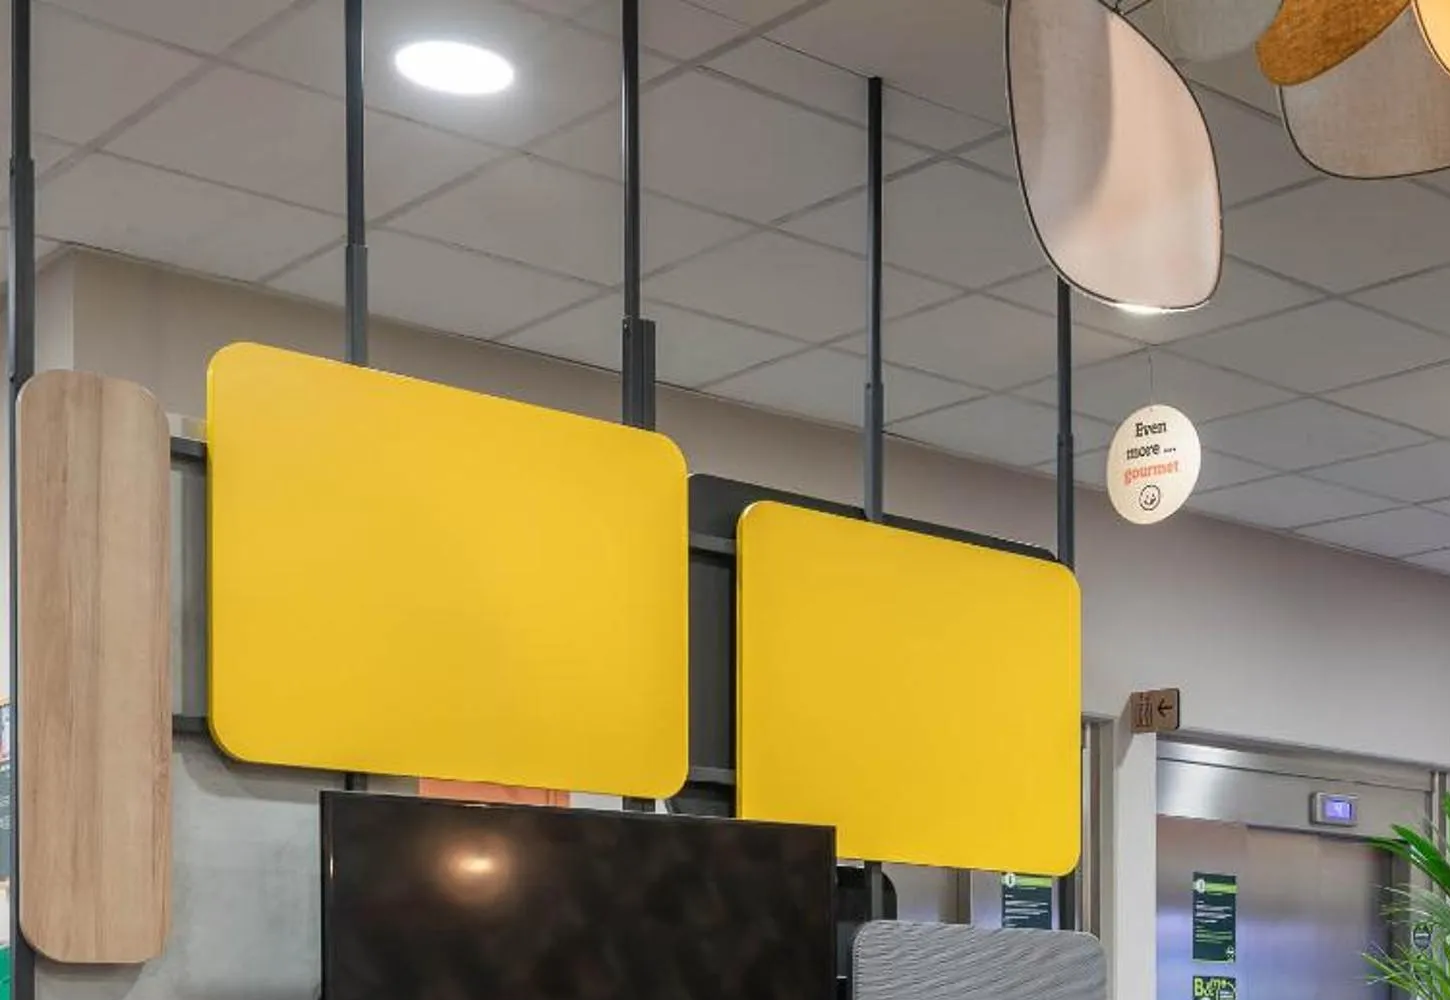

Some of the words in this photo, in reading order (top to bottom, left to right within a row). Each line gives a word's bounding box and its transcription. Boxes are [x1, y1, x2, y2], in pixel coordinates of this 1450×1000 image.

[1135, 421, 1167, 438] Even
[1126, 443, 1160, 460] more
[1123, 461, 1179, 486] gourmet
